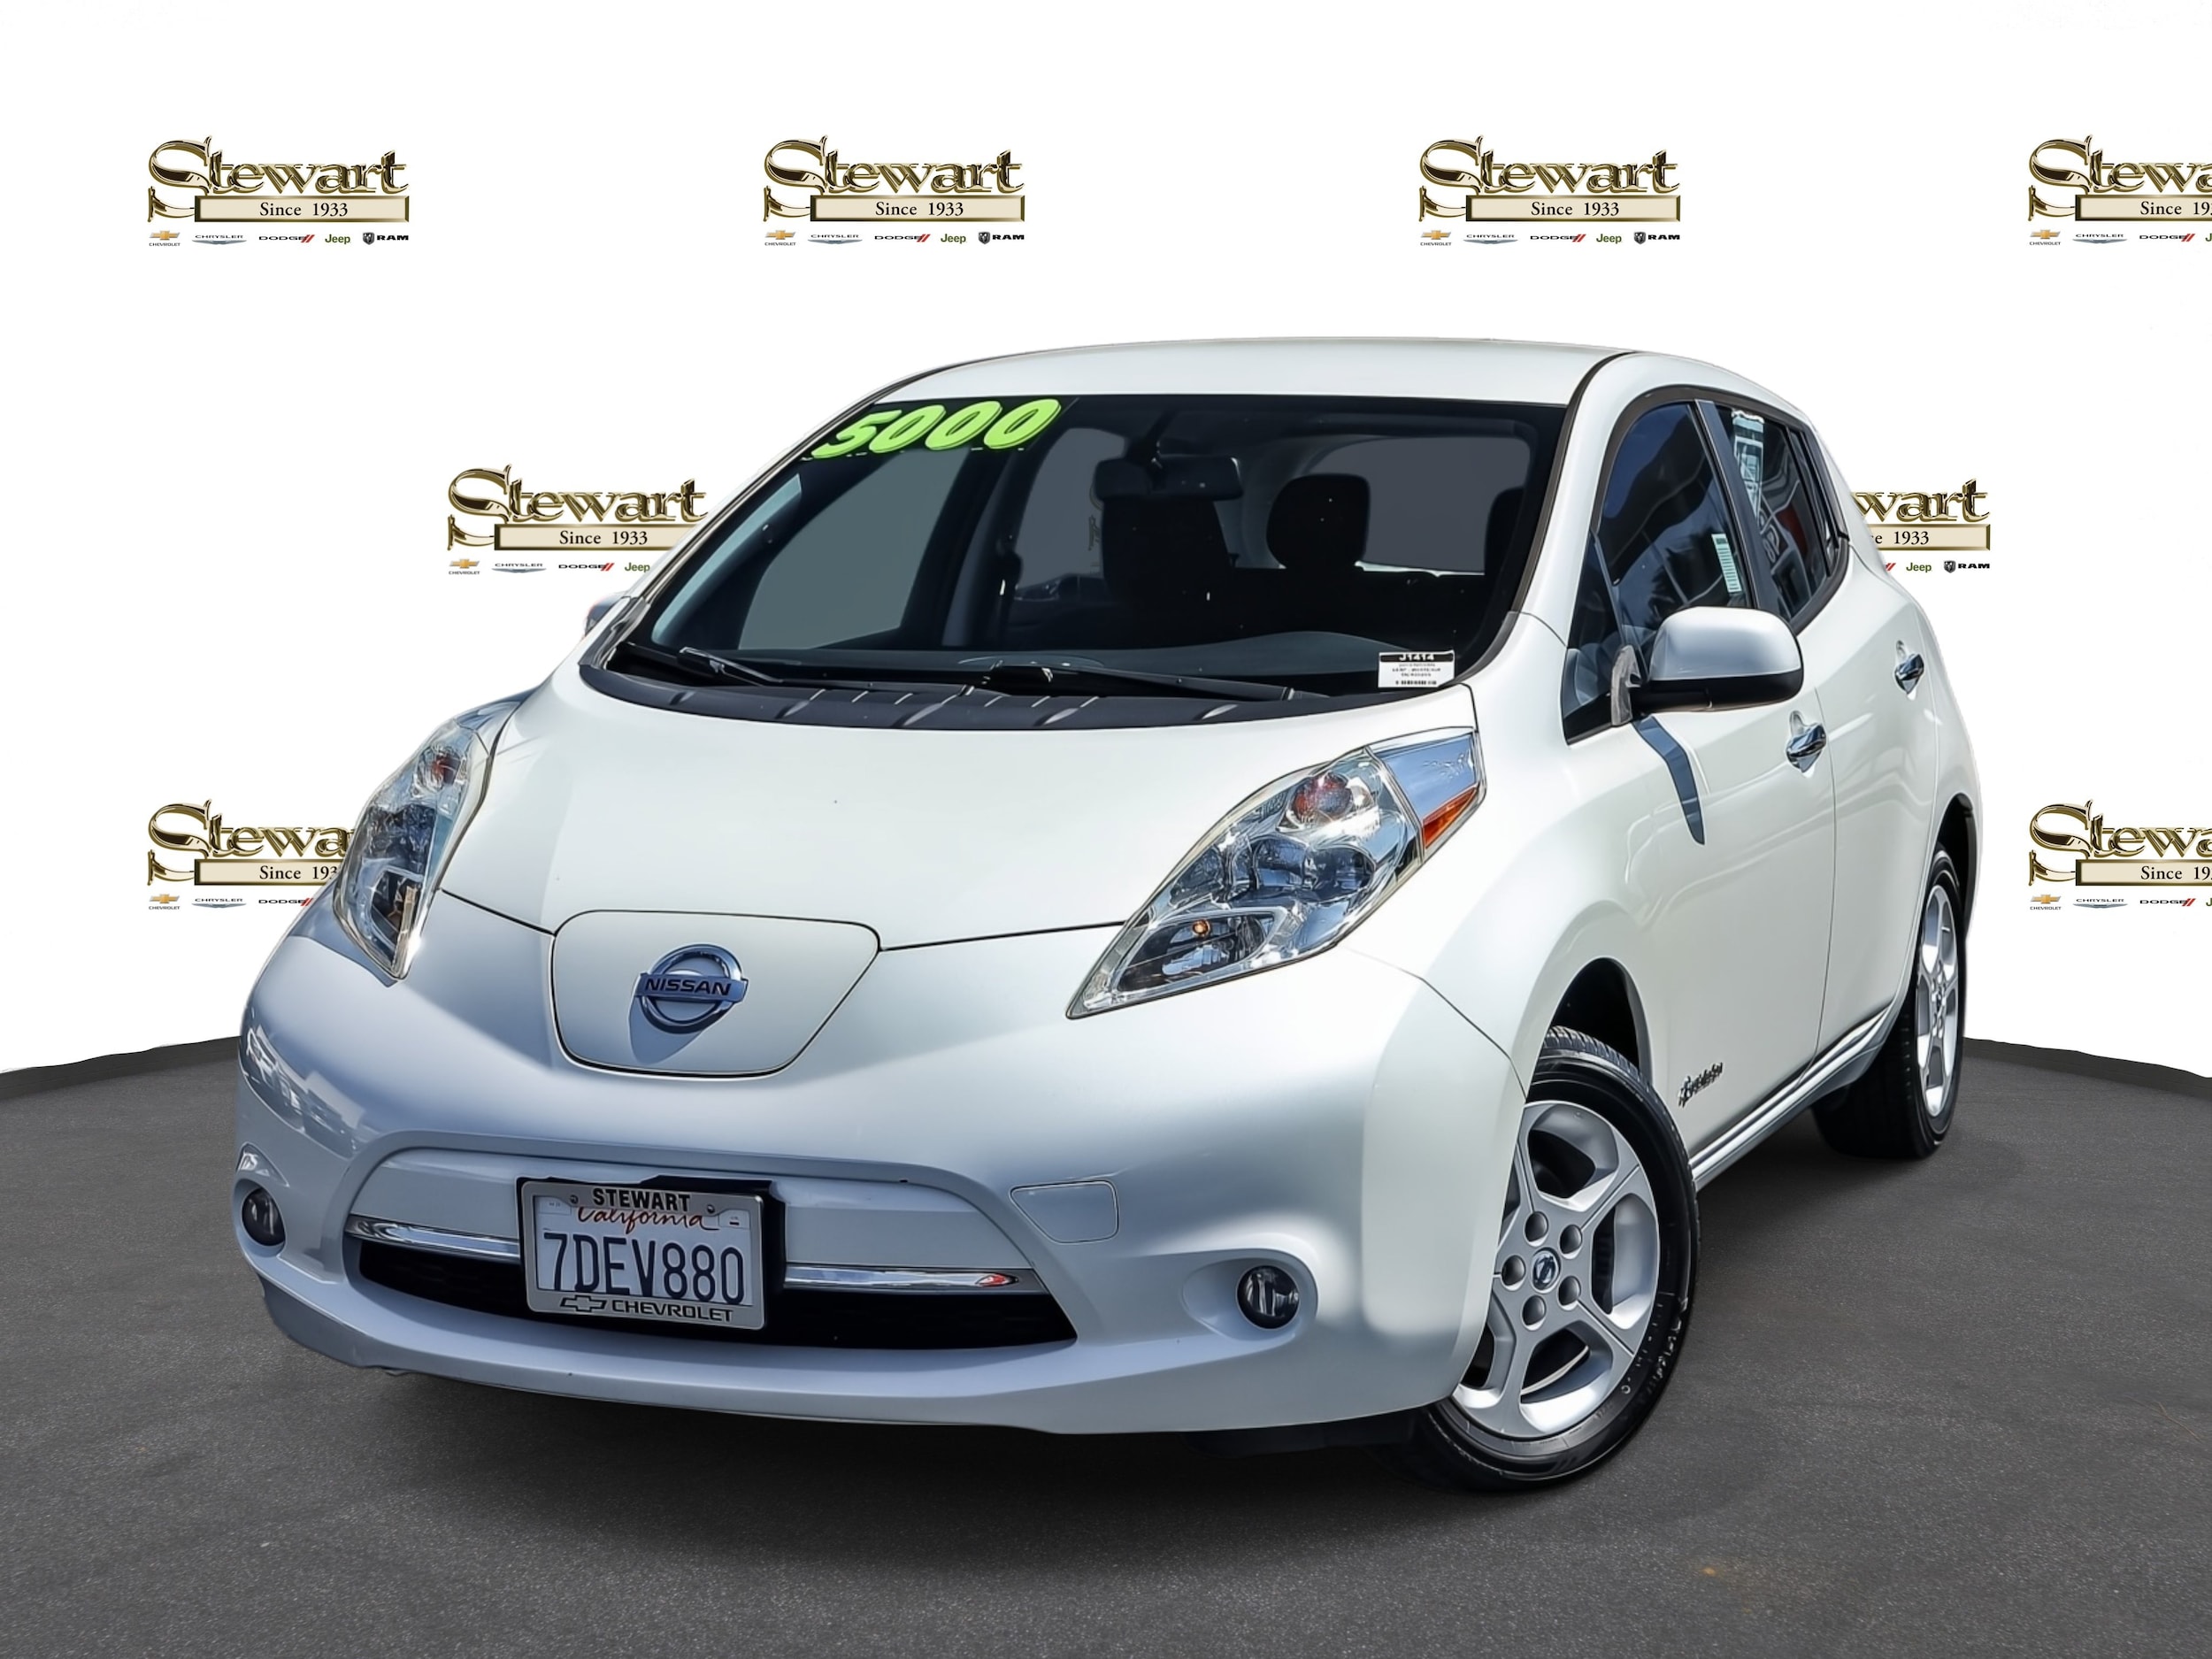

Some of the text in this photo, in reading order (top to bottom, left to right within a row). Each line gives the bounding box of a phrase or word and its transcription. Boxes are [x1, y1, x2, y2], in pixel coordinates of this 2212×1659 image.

[811, 399, 1062, 458] 5000
[645, 979, 732, 995] NISSAN
[593, 1187, 690, 1212] STEWART
[578, 1207, 720, 1234] California
[543, 1233, 744, 1304] 7DEV880
[611, 1299, 733, 1322] CHEVROLET
